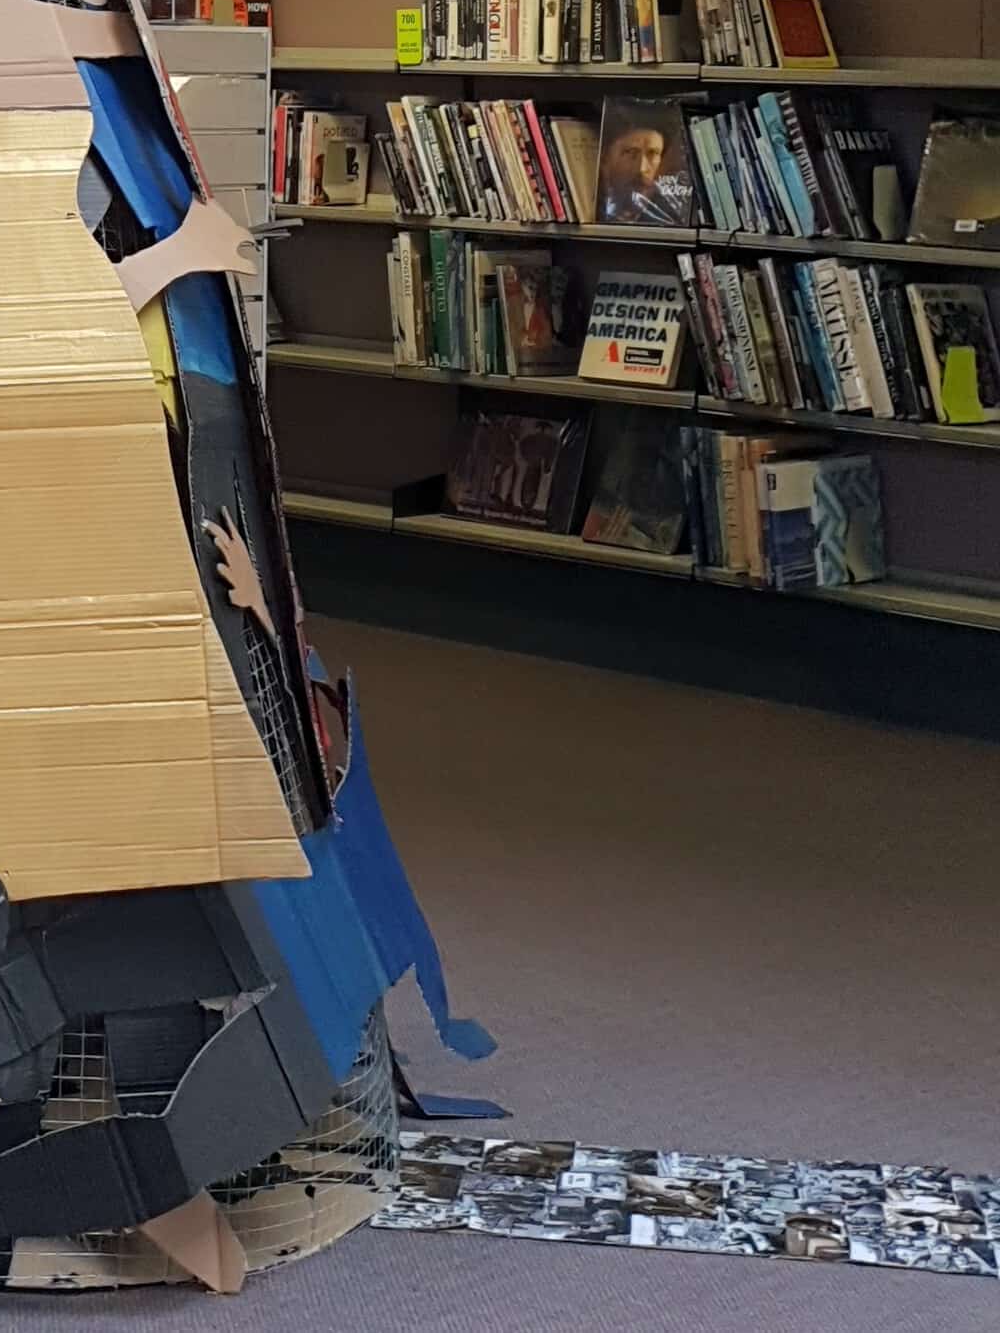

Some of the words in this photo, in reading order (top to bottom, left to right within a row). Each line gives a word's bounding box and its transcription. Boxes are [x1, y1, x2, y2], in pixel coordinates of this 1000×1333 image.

[247, 2, 270, 13] HOW
[401, 14, 415, 24] 700
[597, 282, 677, 302] GRAPHIC
[592, 303, 660, 322] DESIGN
[664, 307, 682, 323] IN
[586, 321, 668, 343] AMERICA
[815, 276, 855, 383] MATISSE
